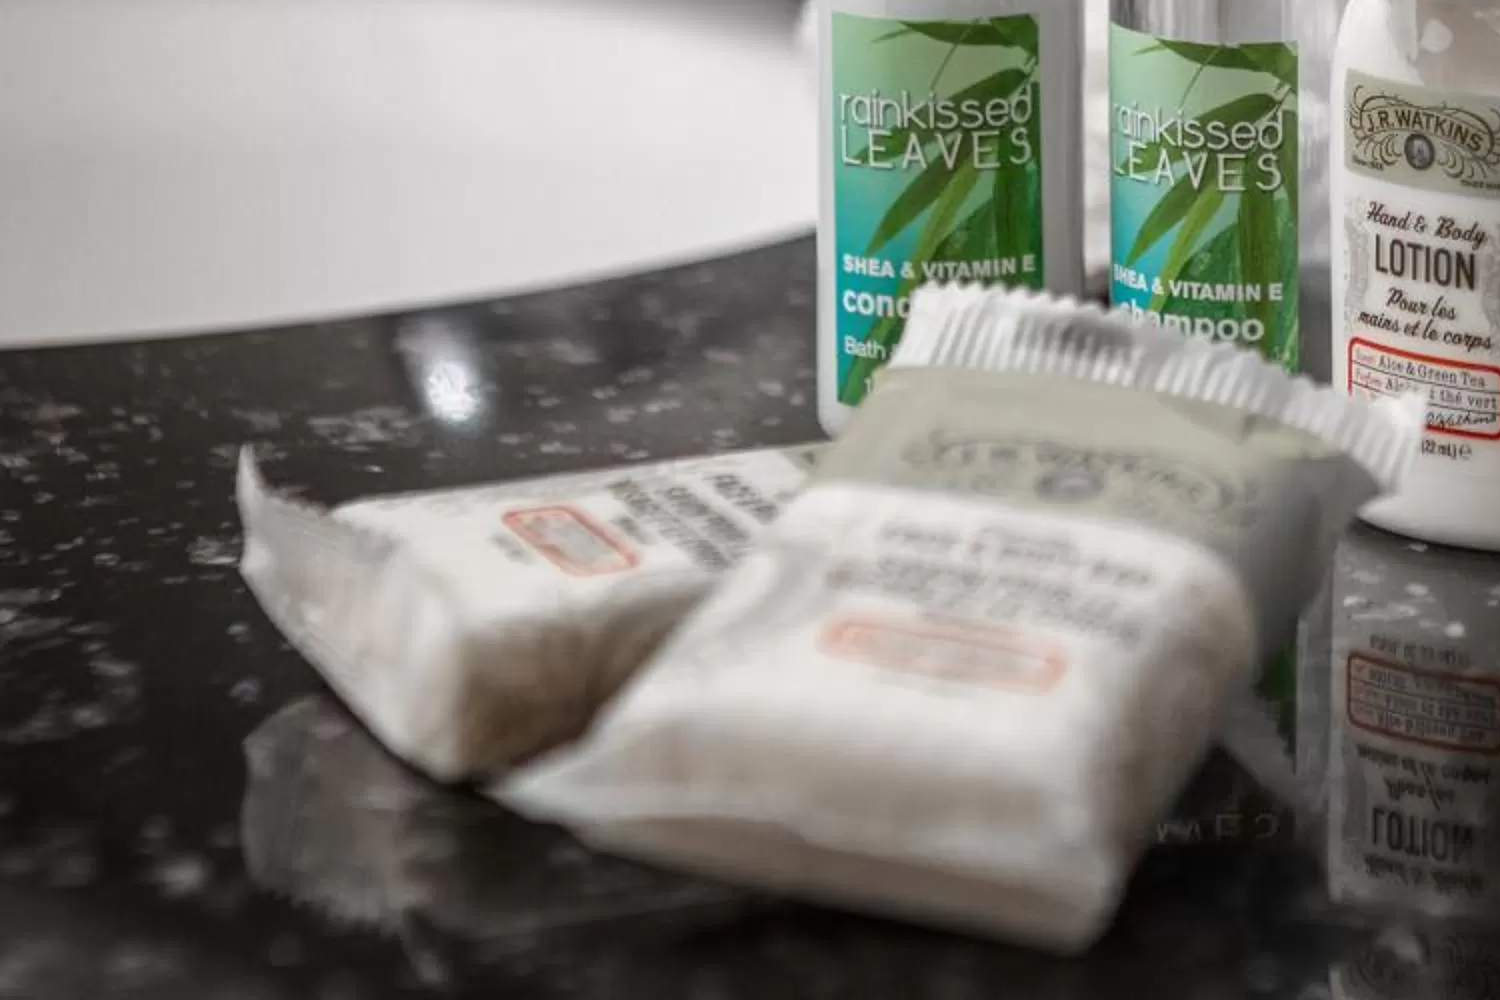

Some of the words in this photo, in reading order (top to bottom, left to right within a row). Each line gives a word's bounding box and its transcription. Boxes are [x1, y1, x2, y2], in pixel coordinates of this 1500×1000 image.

[840, 82, 1032, 130] rainkissed
[841, 125, 1033, 170] LEAVES
[1366, 200, 1411, 232] Hand
[1413, 215, 1428, 234] &
[1434, 214, 1487, 250] Body
[842, 253, 896, 278] SHEA
[900, 261, 915, 279] &
[921, 256, 1019, 279] VITAMIN
[1022, 254, 1036, 273] E
[1375, 234, 1475, 290] LOTION
[1151, 277, 1164, 295] &
[1168, 279, 1261, 302] VITAMIN
[1268, 282, 1284, 300] E
[1385, 286, 1429, 315] Pour
[1430, 296, 1456, 320] les
[843, 335, 887, 360] Bath
[1357, 311, 1400, 333] mains
[1402, 319, 1418, 337] et
[1422, 318, 1438, 342] le
[1442, 332, 1493, 352] corps
